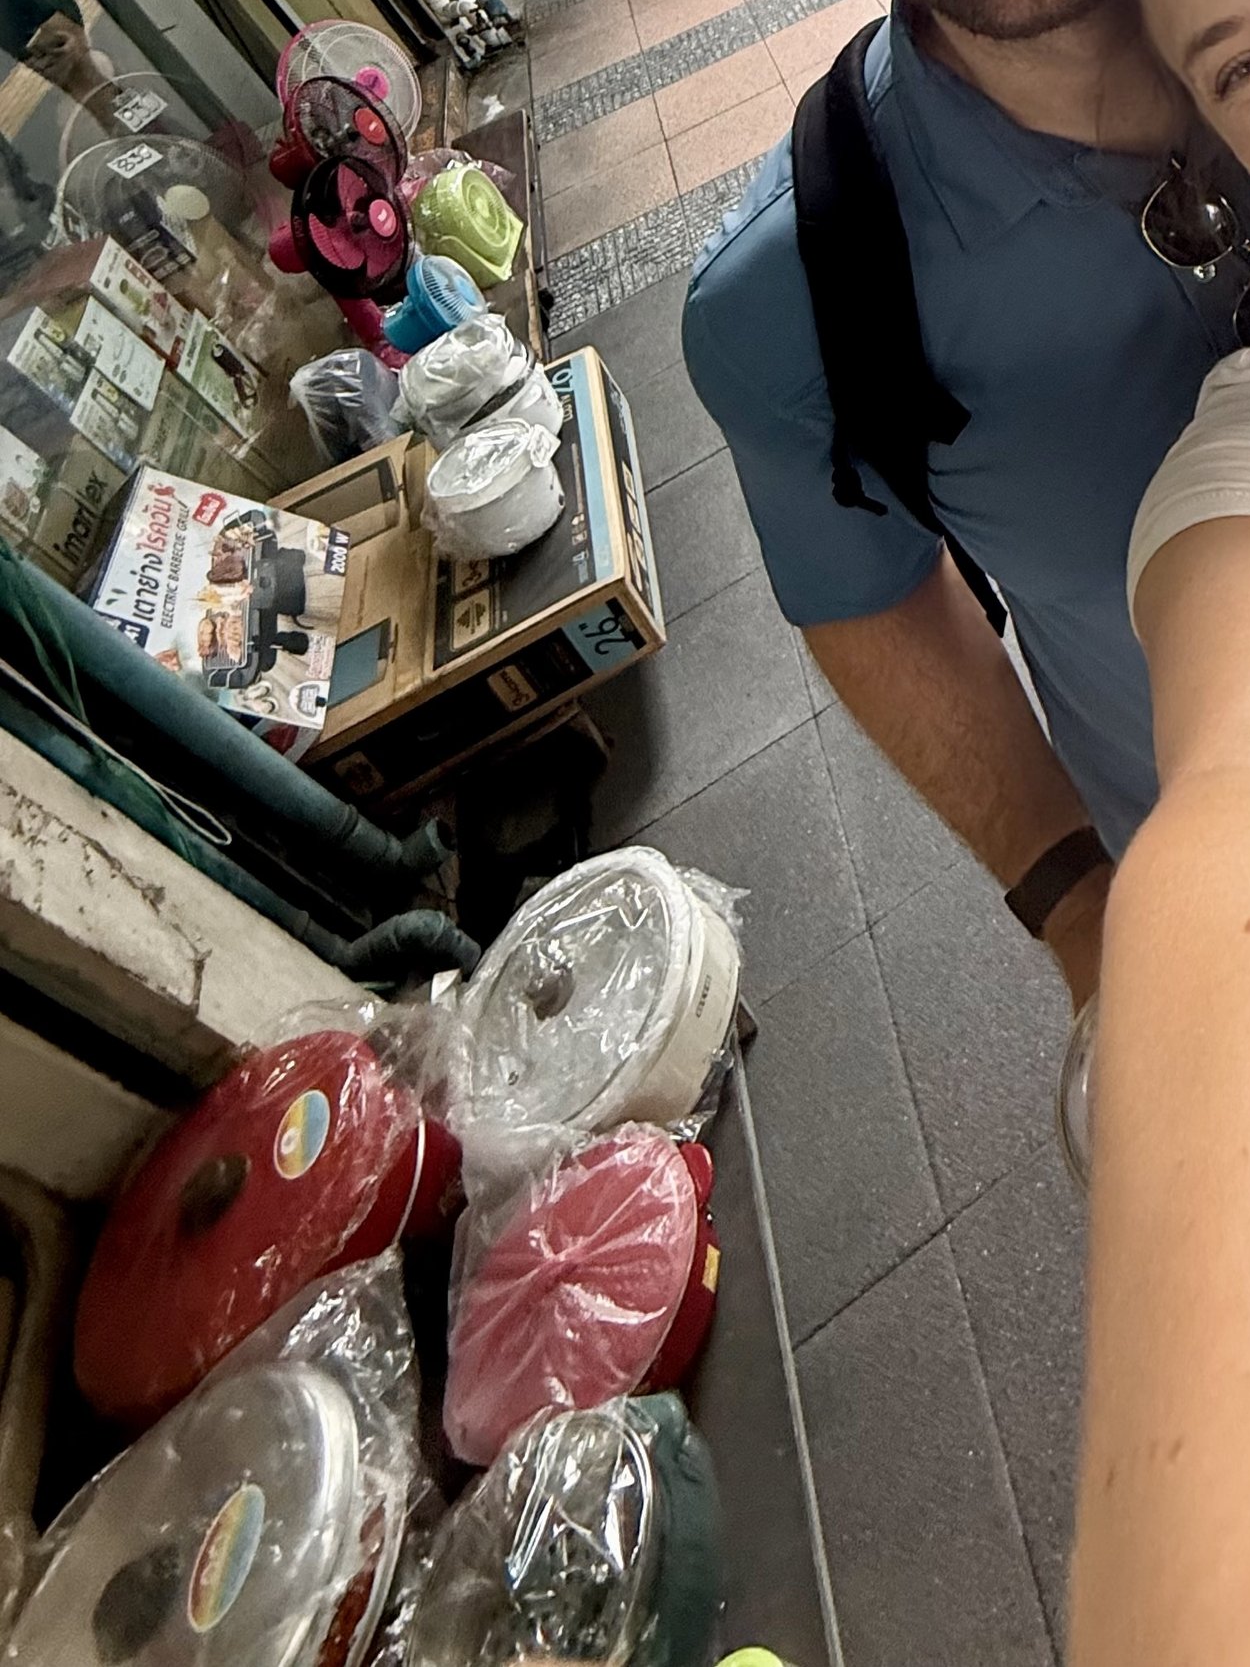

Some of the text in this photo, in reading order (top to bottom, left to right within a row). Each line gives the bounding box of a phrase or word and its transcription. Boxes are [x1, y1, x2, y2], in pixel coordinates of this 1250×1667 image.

[161, 584, 178, 629] ELECTRIC
[171, 536, 188, 583] BARBECUE
[332, 532, 351, 574] 2000 W
